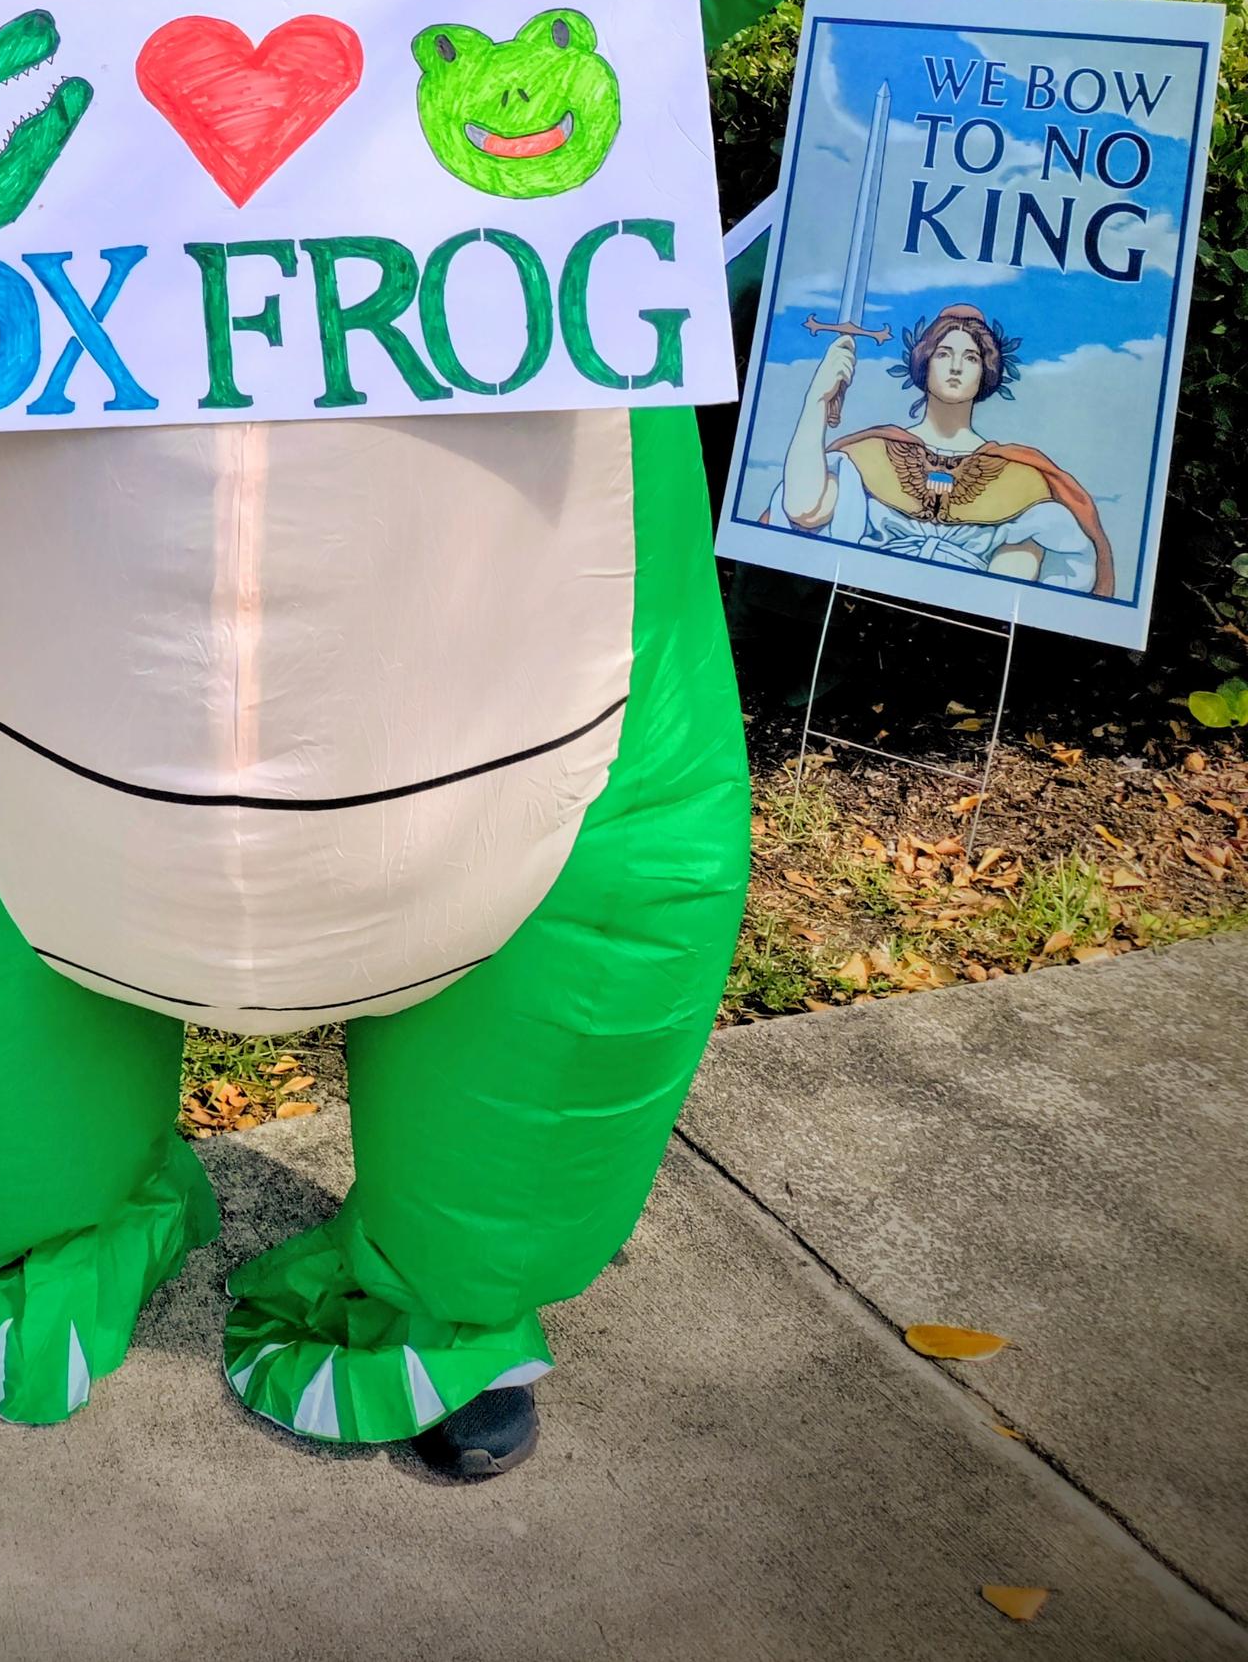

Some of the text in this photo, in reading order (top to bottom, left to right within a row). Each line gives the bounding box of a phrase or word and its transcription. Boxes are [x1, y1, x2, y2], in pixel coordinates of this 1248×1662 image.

[922, 55, 1173, 118] WE BOW
[915, 112, 1152, 190] TO NO
[901, 180, 1150, 283] KING
[184, 219, 691, 409] FROG
